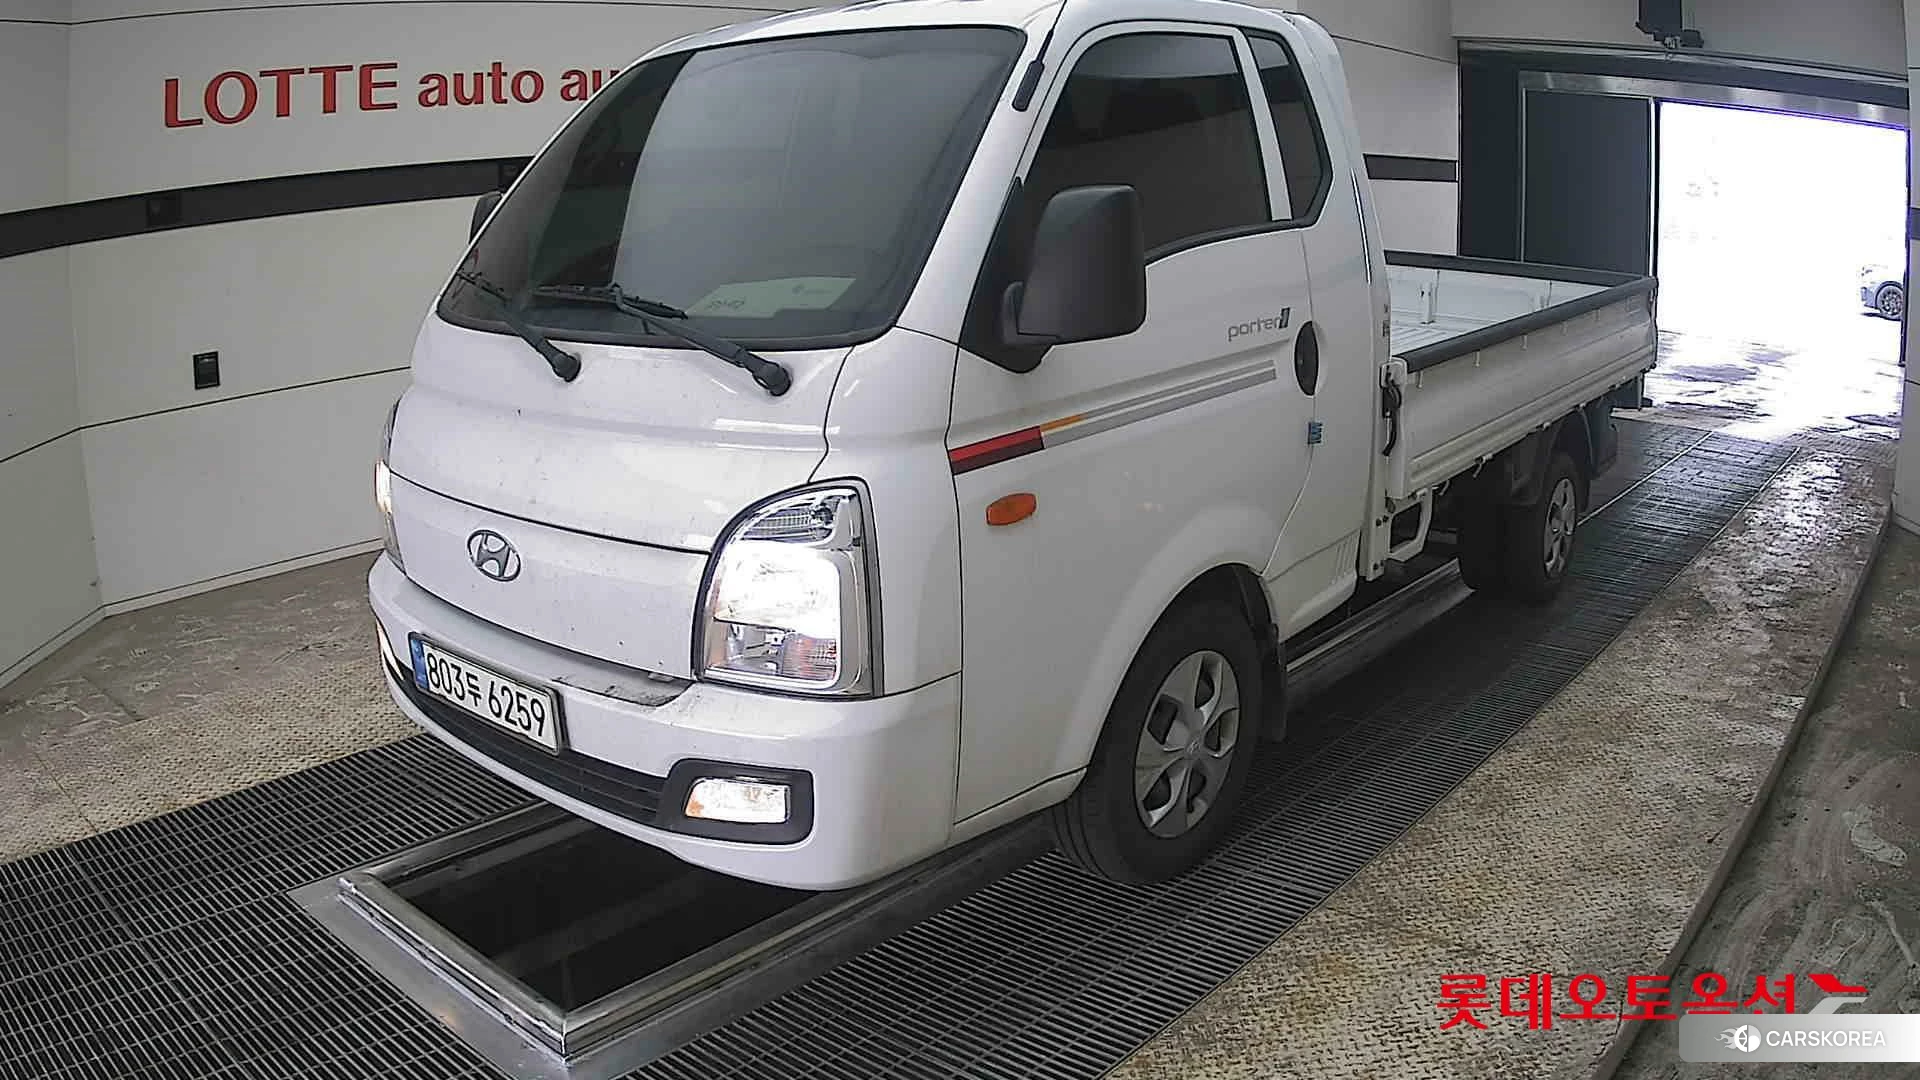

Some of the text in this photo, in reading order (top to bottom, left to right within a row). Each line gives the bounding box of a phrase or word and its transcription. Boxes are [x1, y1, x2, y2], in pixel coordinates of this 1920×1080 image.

[164, 62, 399, 128] LOTTE
[418, 61, 545, 108] auto
[427, 652, 546, 737] 803두 6259
